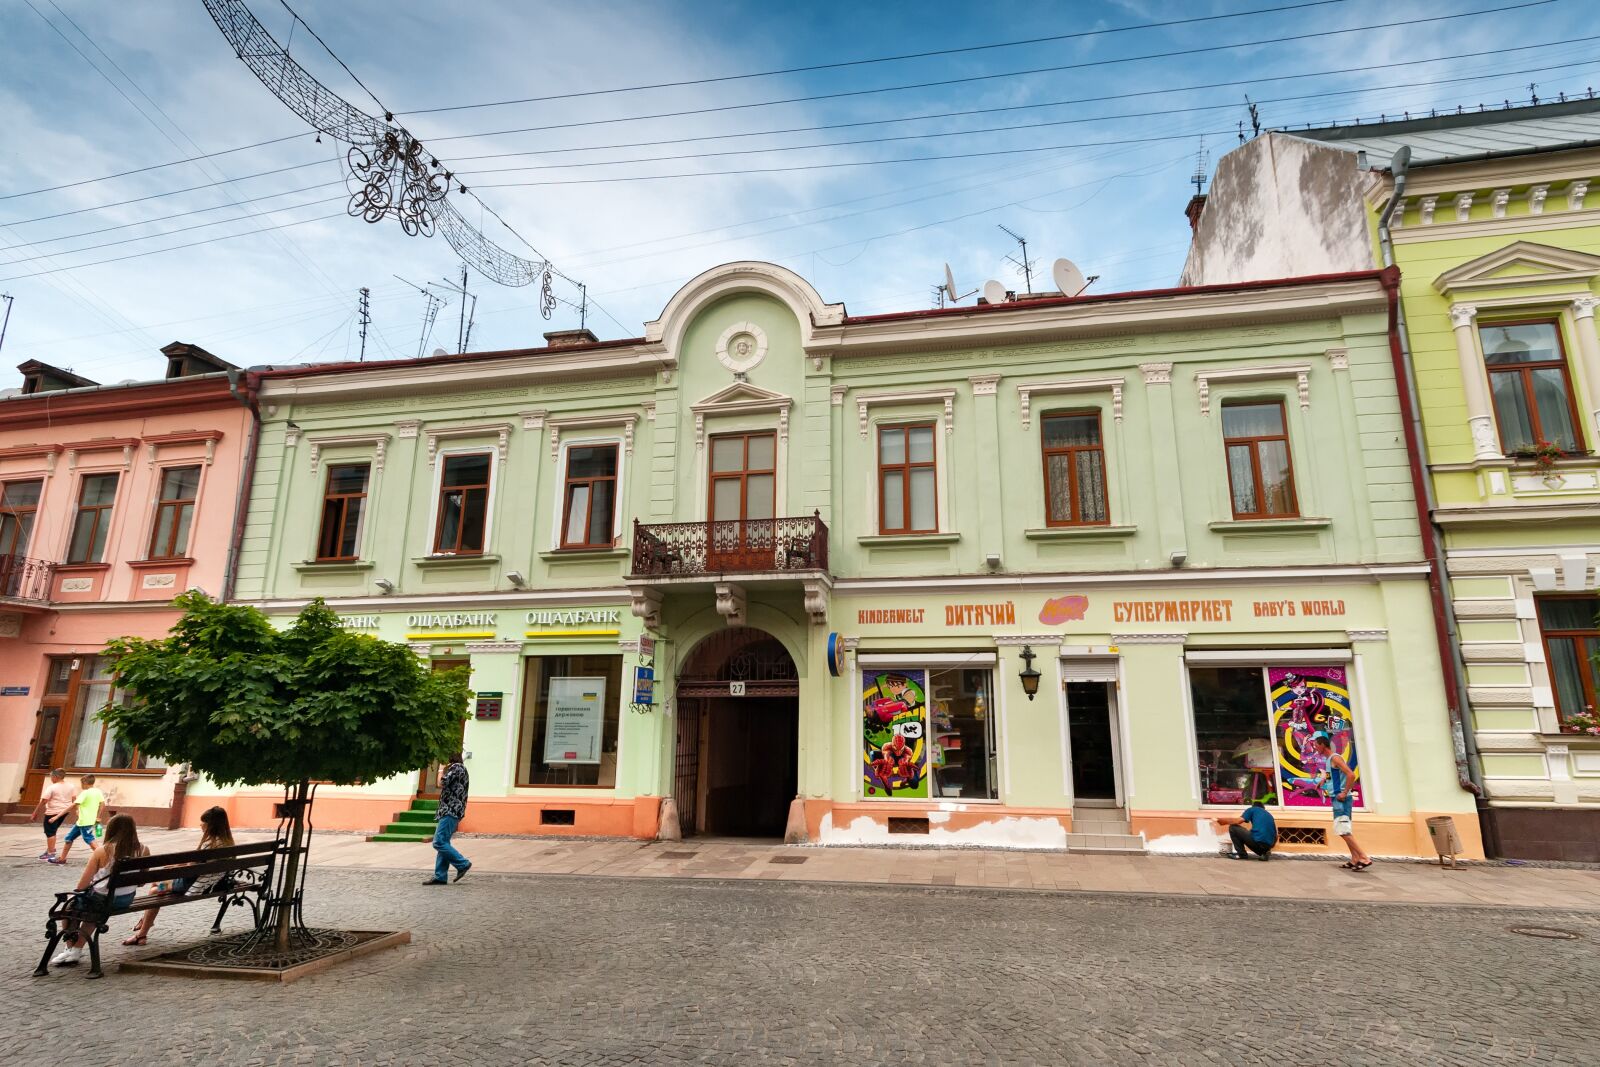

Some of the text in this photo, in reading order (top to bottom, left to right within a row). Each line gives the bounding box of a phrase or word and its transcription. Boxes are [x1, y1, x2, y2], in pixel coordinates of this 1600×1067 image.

[858, 608, 925, 624] KINDERWELT
[945, 600, 1016, 626] ДИТЯЧИЙ
[1113, 599, 1233, 622] СУПЕРМАРКЕТ
[1253, 599, 1346, 617] BABY'S WORLD
[406, 613, 496, 629] ОЩАДБАНК
[525, 611, 620, 626] ОЩАДБАНК
[732, 684, 743, 694] 27
